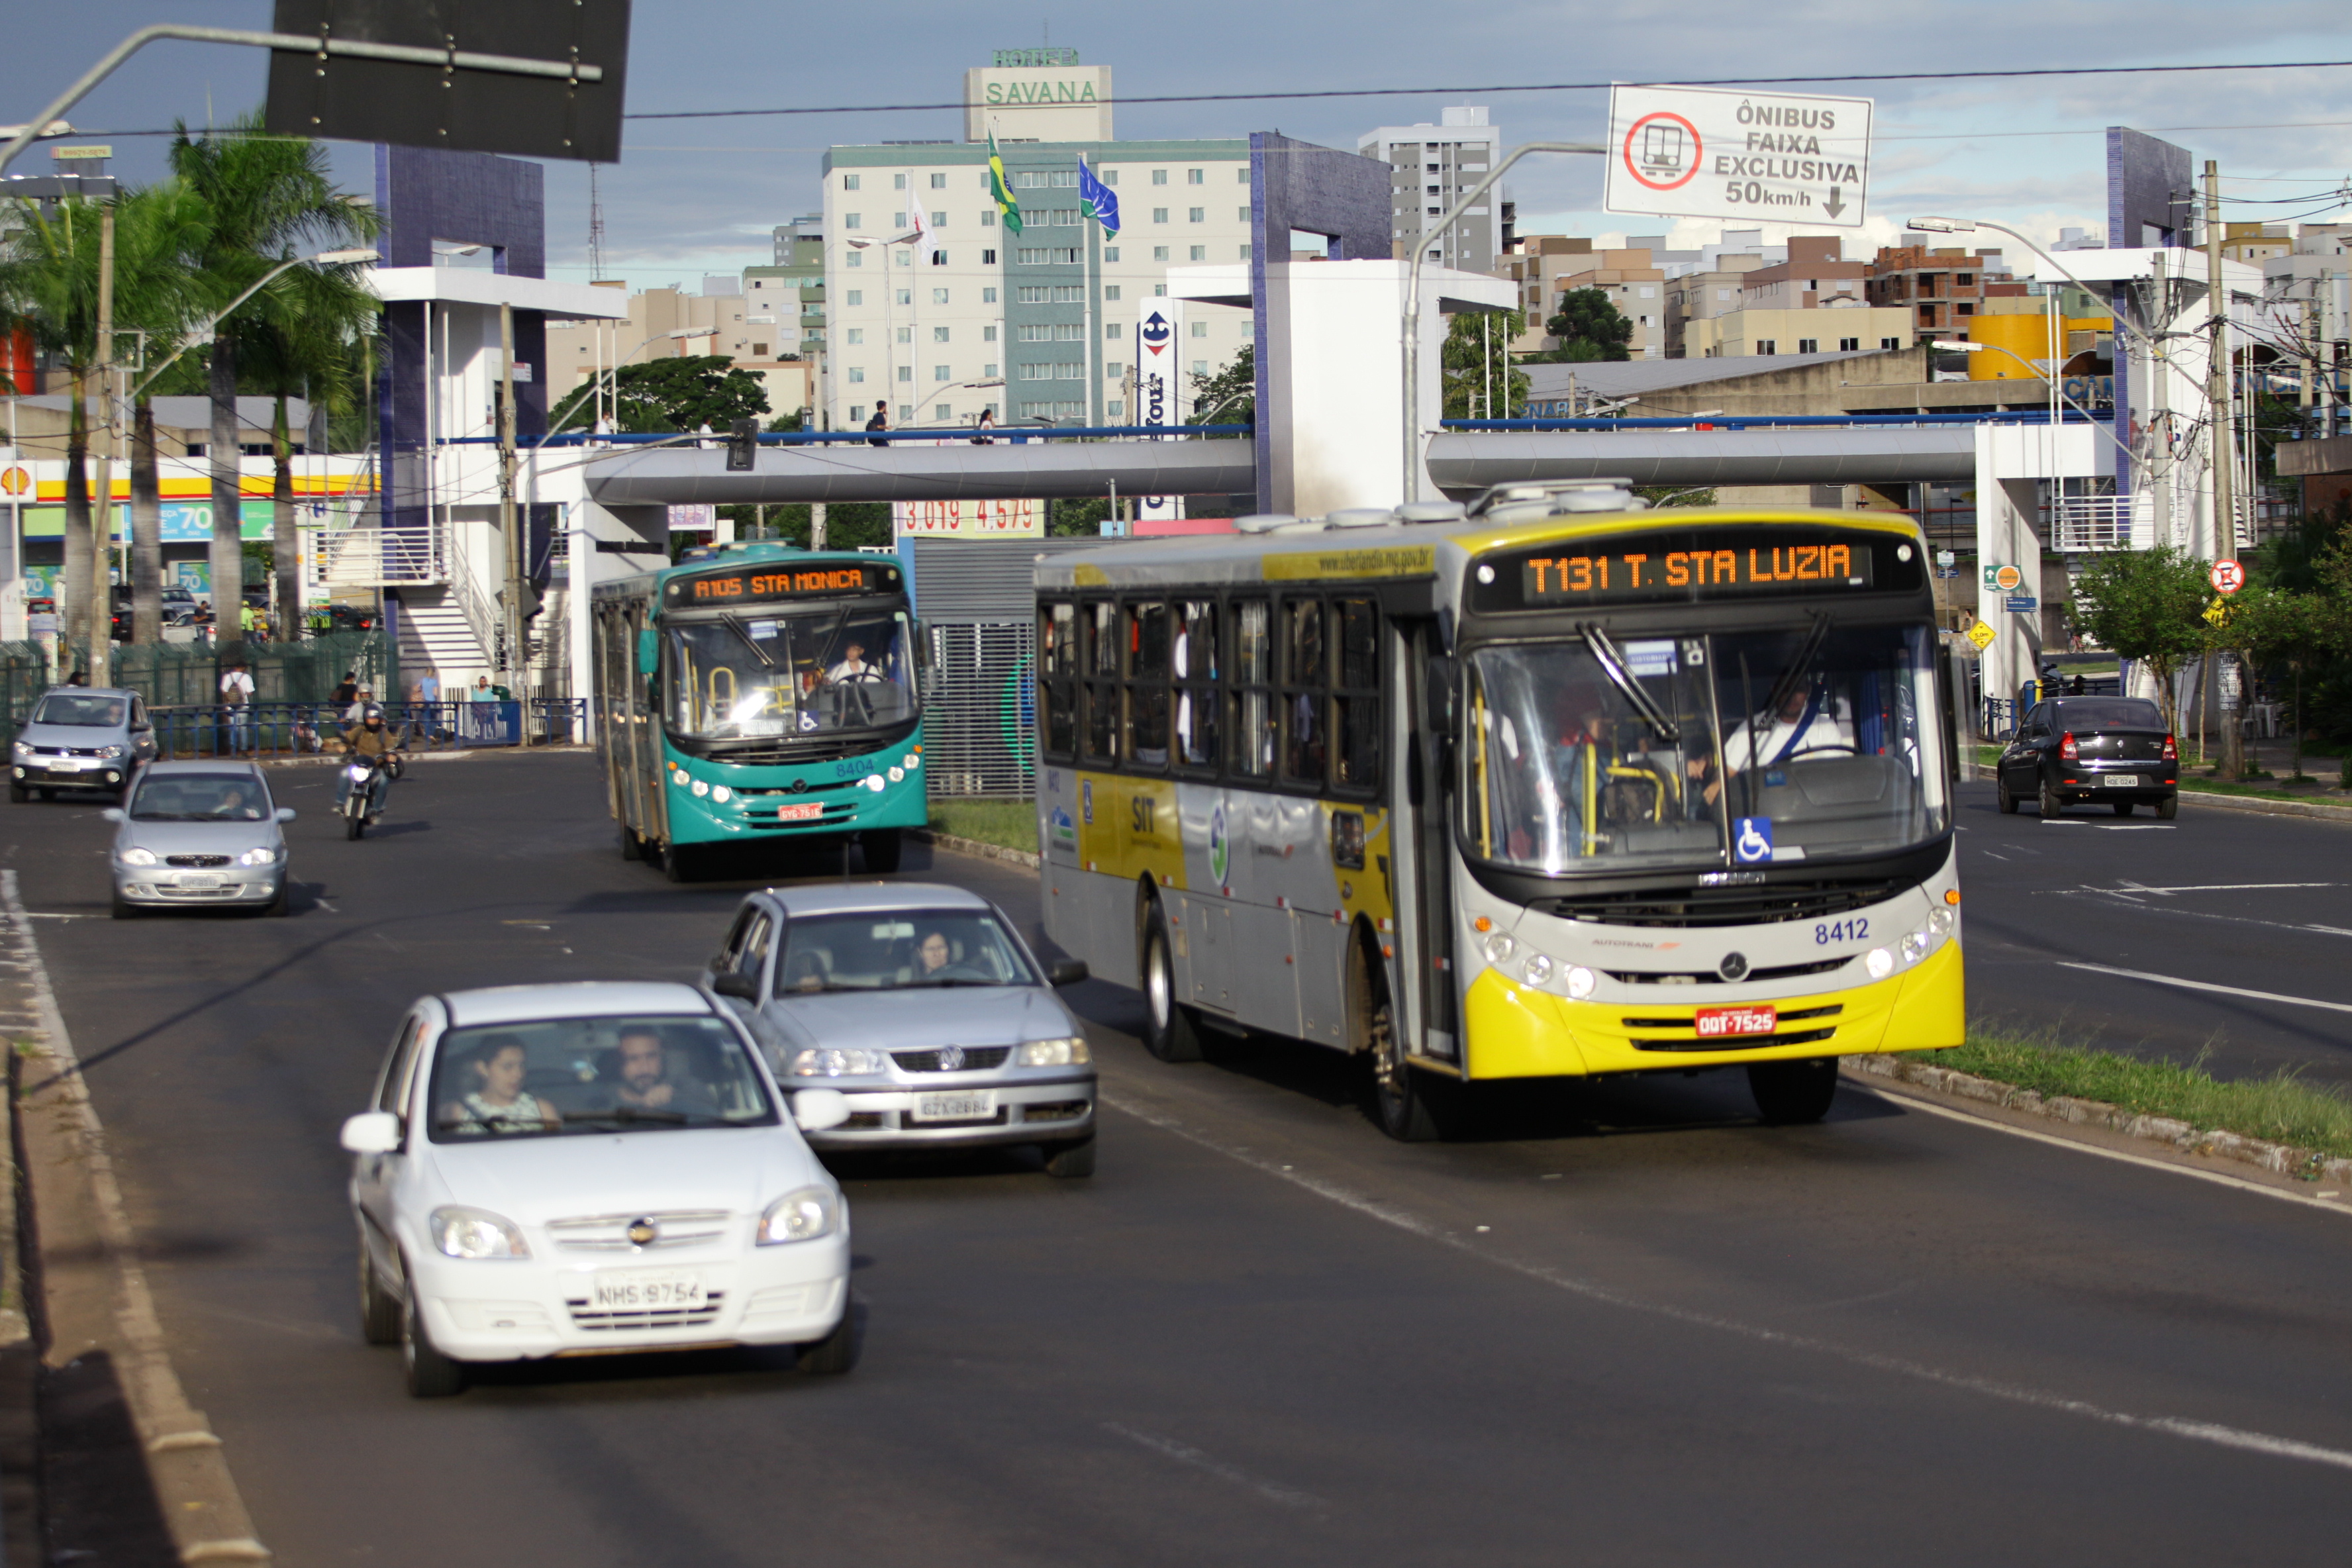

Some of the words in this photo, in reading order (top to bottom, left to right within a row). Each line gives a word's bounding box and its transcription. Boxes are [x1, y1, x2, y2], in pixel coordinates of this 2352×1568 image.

[993, 48, 1071, 68] HOTEL
[986, 81, 1097, 104] SAVANA
[1736, 99, 1836, 130] ÔNIBUS
[1746, 132, 1821, 156] FAIXA
[1714, 155, 1860, 183] EXCLUSIVA
[1725, 181, 1812, 207] 50km/h
[178, 507, 213, 529] 70
[1528, 556, 1608, 593] T131
[1624, 554, 1653, 589] T.
[1665, 549, 1737, 587] STA
[1749, 544, 1850, 583] LUZIA
[695, 577, 742, 597] A105
[750, 574, 790, 594] STA
[795, 569, 862, 591] MONICA
[836, 758, 875, 777] 8404
[1133, 795, 1155, 833] SIT
[1815, 918, 1869, 945] 8412
